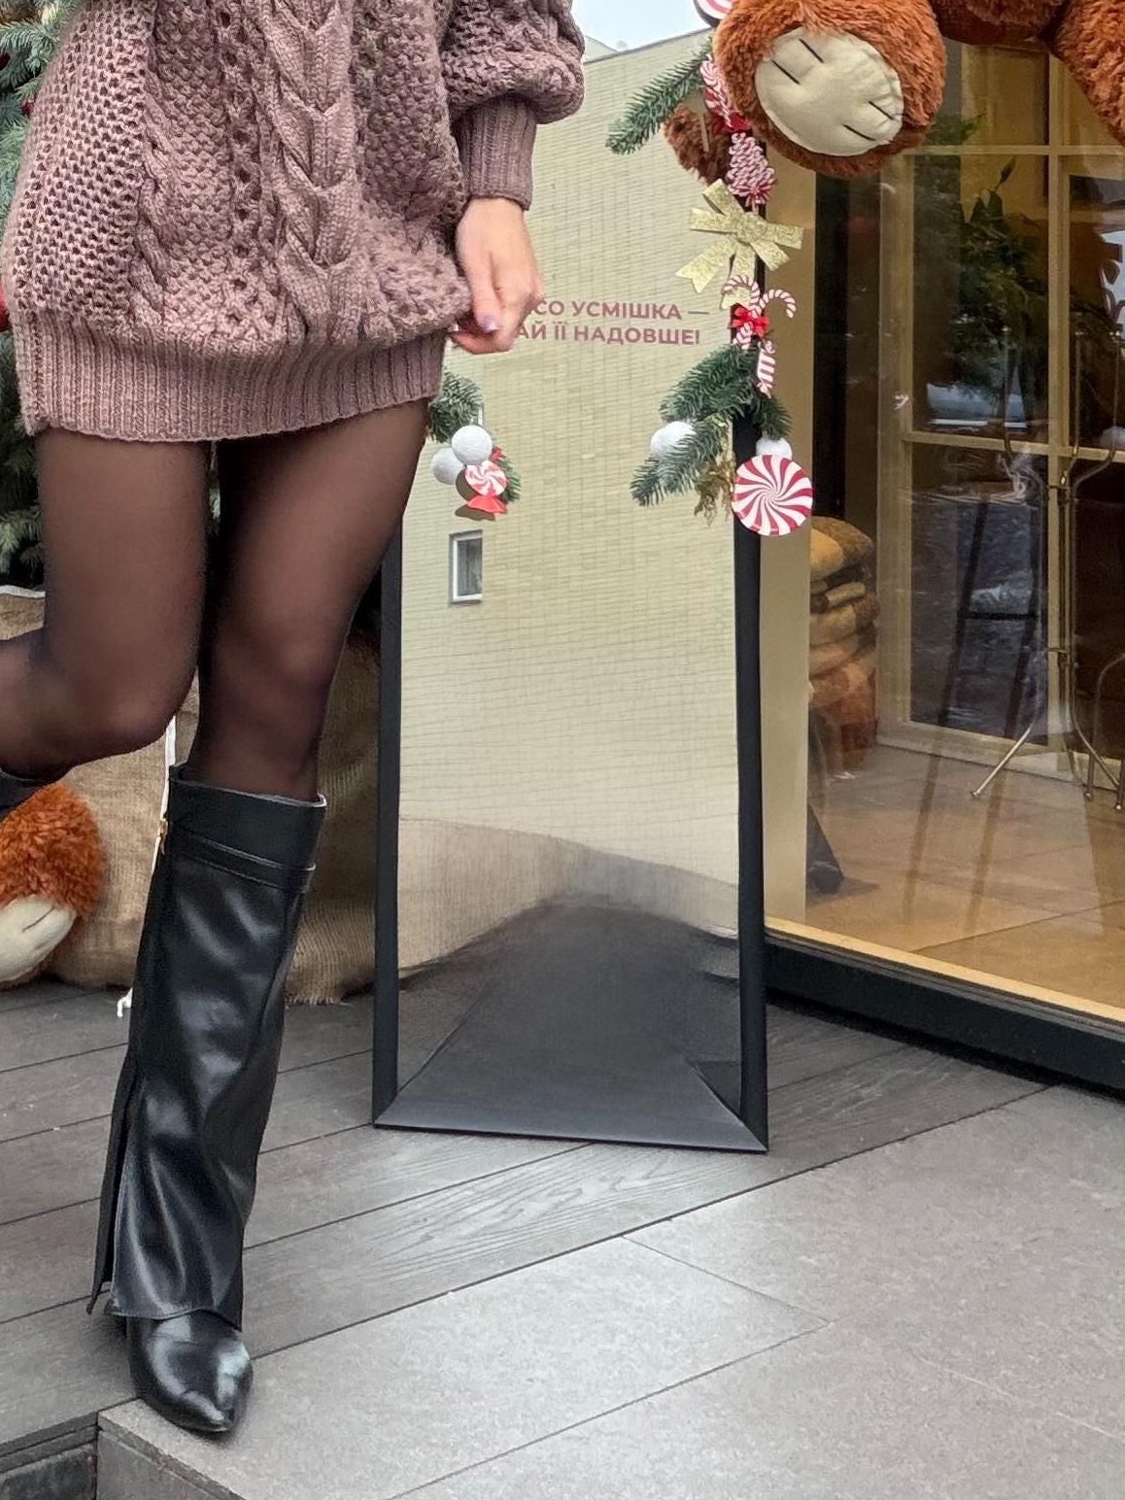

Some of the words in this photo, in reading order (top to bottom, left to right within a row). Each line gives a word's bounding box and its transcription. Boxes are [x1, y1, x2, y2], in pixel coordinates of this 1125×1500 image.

[534, 299, 565, 316] СО
[571, 300, 682, 320] УСМІШКА
[514, 320, 547, 341] АЙ
[552, 320, 568, 341] ЇЇ
[574, 325, 700, 346] НАДОВШЕ!
